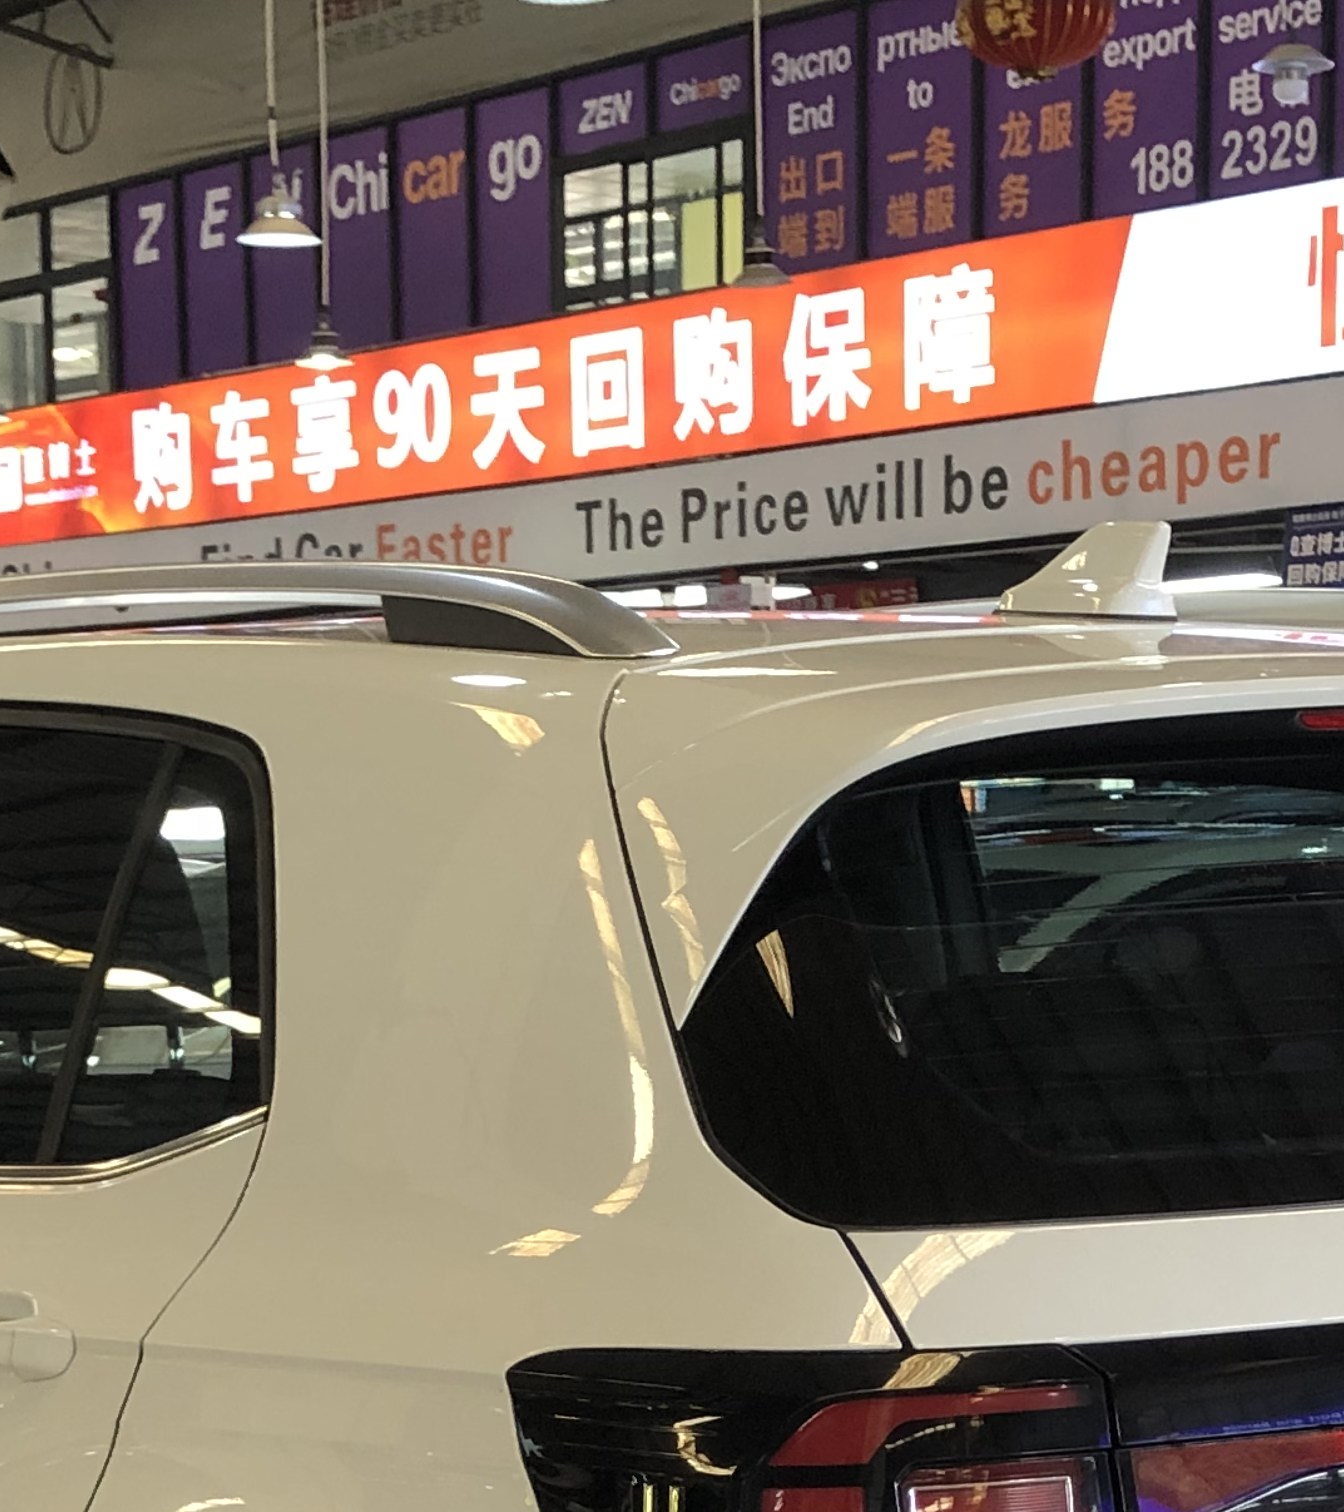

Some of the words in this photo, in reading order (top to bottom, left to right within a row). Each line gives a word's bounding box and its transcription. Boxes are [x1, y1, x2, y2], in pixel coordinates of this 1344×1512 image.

[577, 89, 634, 135] ZEN
[787, 94, 836, 137] End
[906, 78, 935, 110] to
[1102, 17, 1199, 70] export
[1217, 0, 1323, 44] service
[488, 133, 544, 202] go
[1130, 140, 1195, 195] 188
[1220, 115, 1319, 180] 2329
[130, 263, 997, 515] 购车享90天回购保障
[575, 493, 664, 555] The
[680, 480, 810, 544] Price
[824, 455, 925, 526] will
[943, 453, 1009, 514] be
[1026, 430, 1282, 507] cheaper
